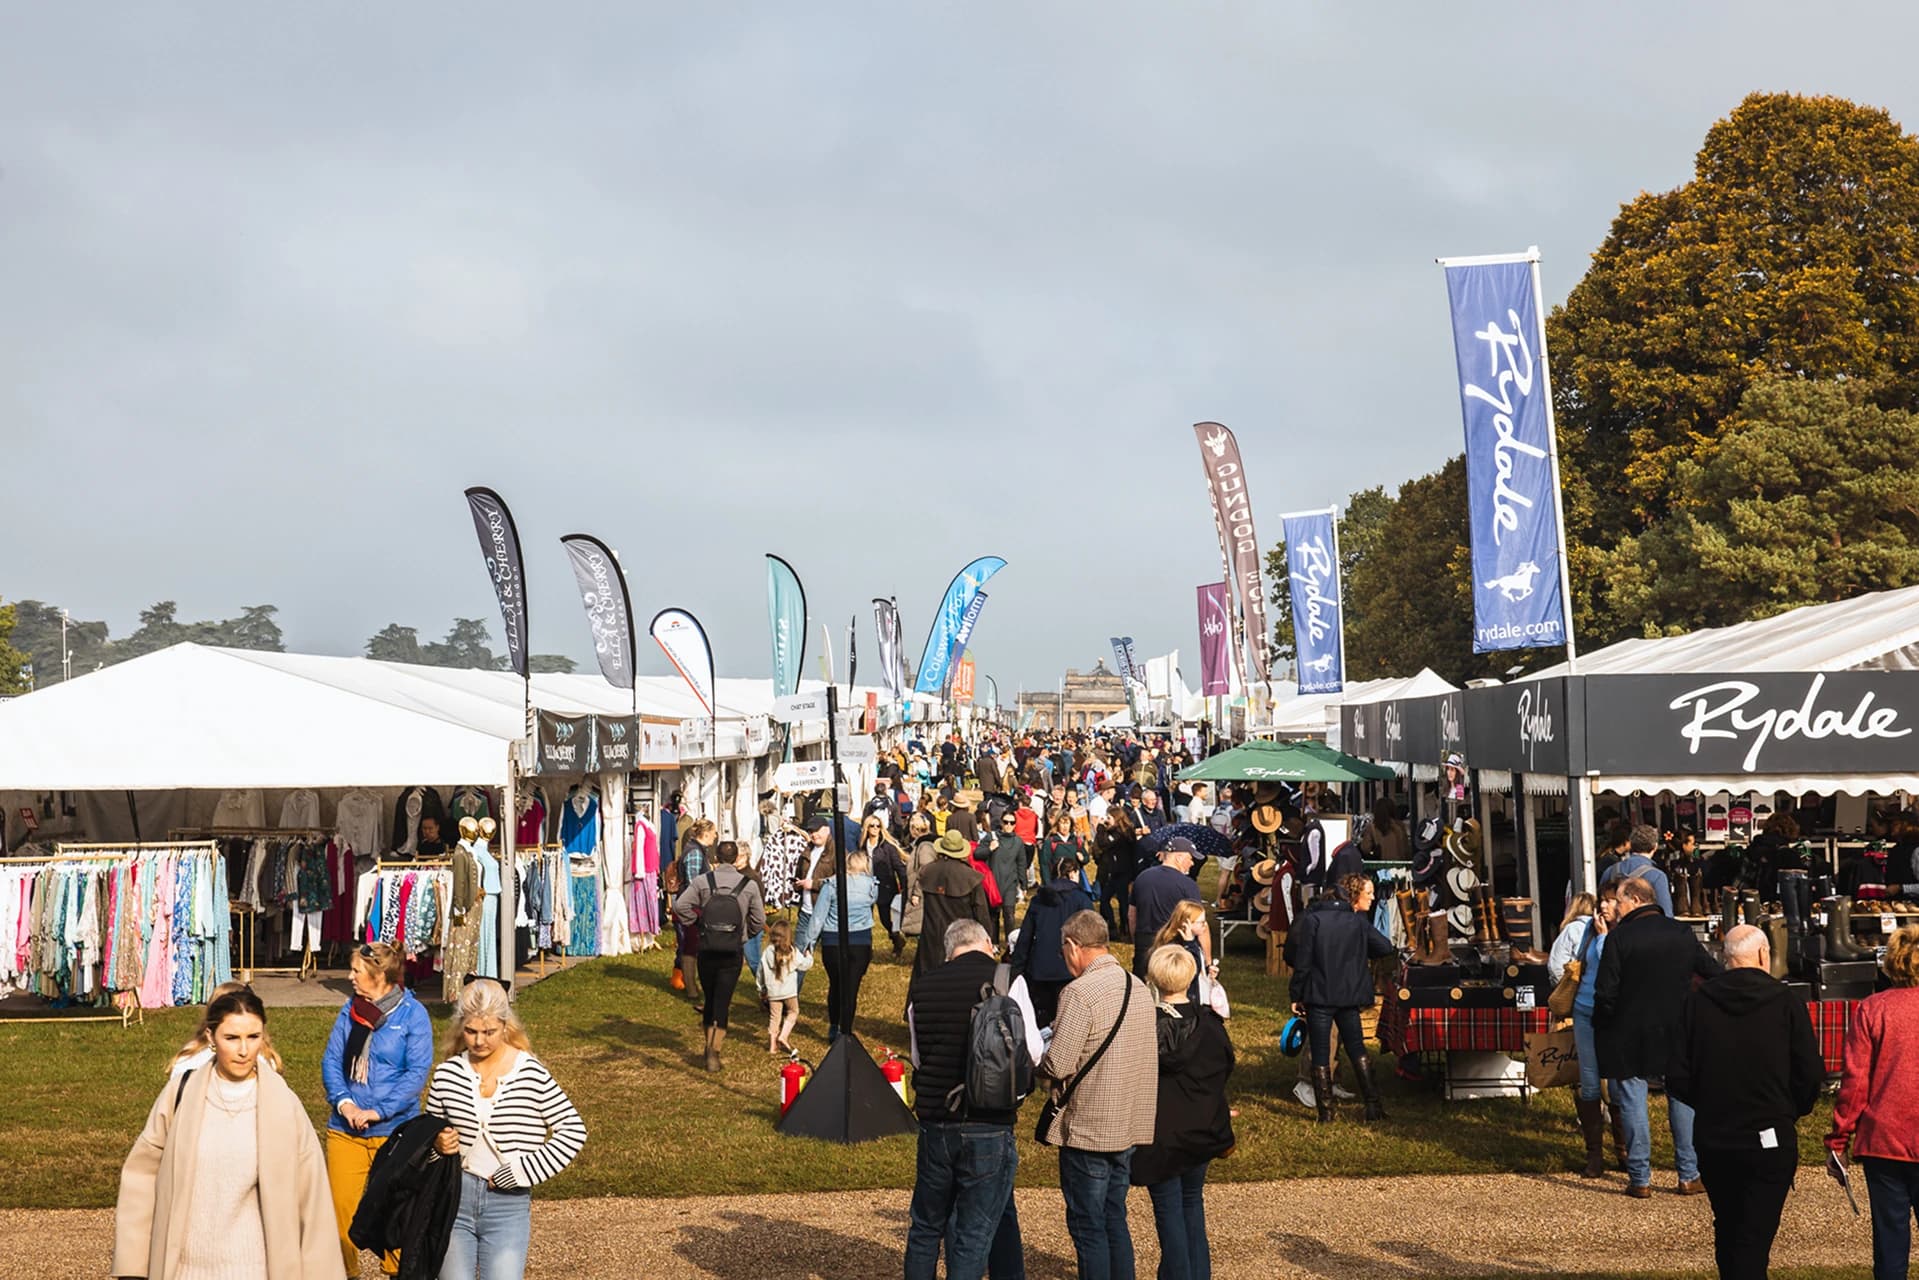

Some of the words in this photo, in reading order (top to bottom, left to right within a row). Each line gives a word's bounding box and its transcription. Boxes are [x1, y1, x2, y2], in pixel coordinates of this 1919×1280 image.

[1465, 307, 1546, 546] Rydale
[485, 507, 512, 581] CHERRY
[503, 584, 512, 598] &
[956, 594, 985, 645] Aviform
[1290, 535, 1338, 647] Rydale
[1479, 618, 1561, 644] rydale.com
[802, 702, 816, 710] STAGE
[1517, 681, 1554, 771] Rydale
[1669, 672, 1913, 773] Rydale
